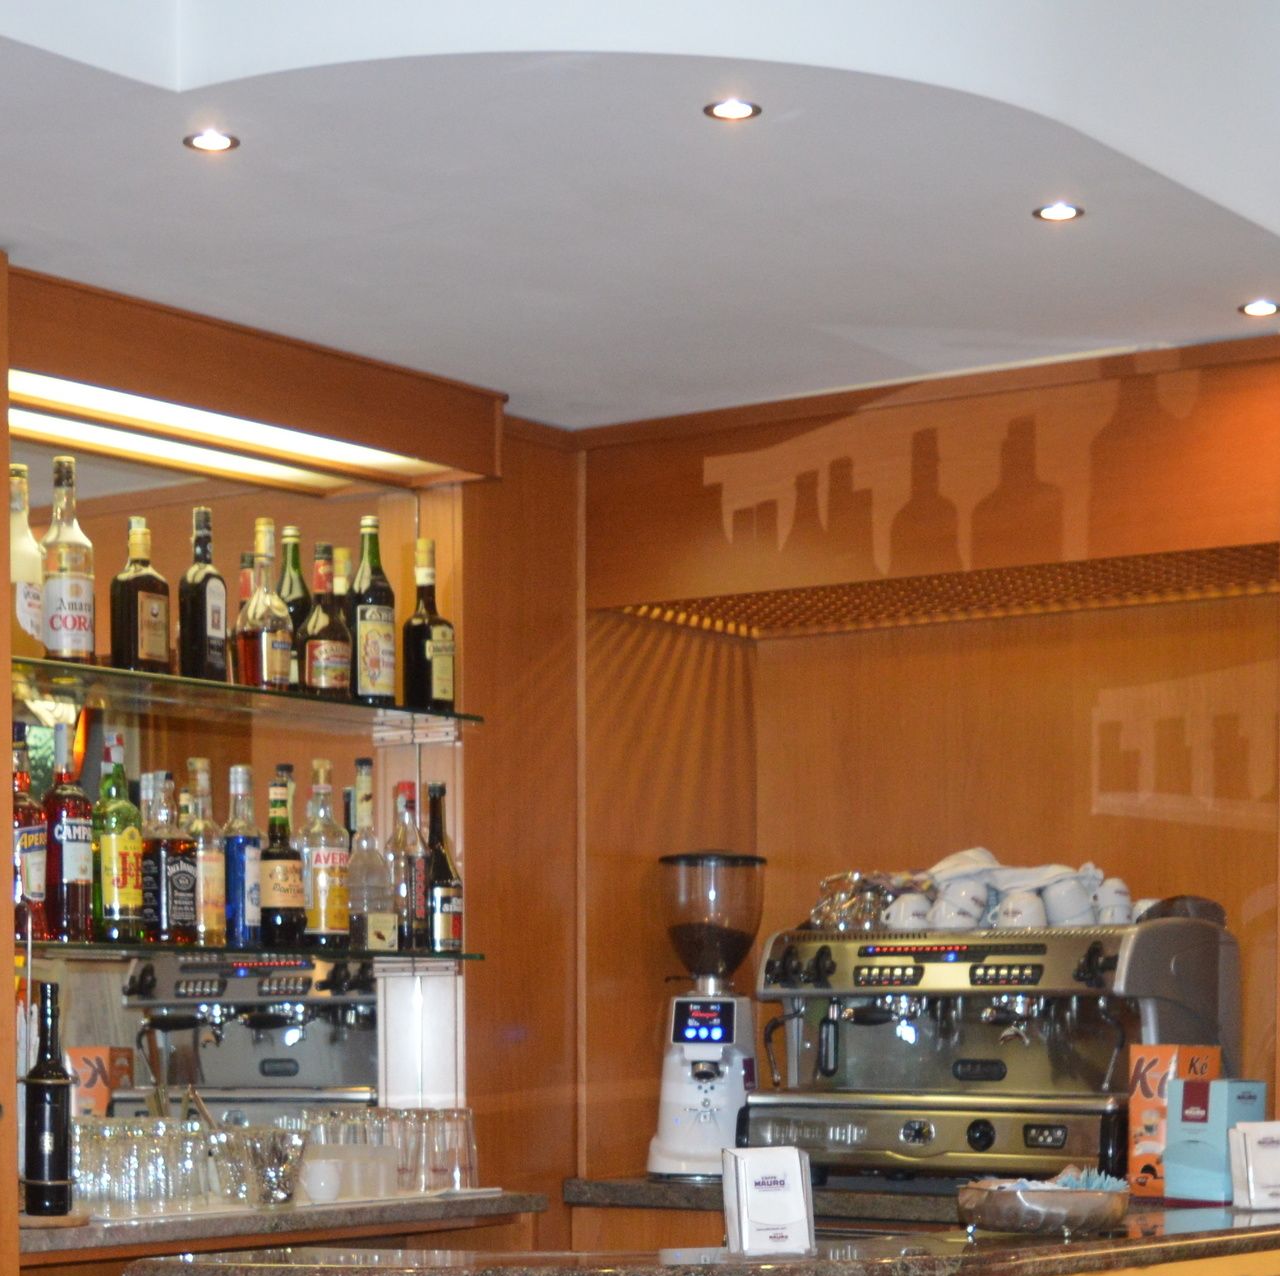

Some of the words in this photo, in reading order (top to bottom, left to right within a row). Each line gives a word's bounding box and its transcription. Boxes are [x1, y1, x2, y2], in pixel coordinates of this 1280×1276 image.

[19, 832, 48, 849] APER
[1188, 1055, 1210, 1076] Ké
[754, 1179, 785, 1187] MAURO
